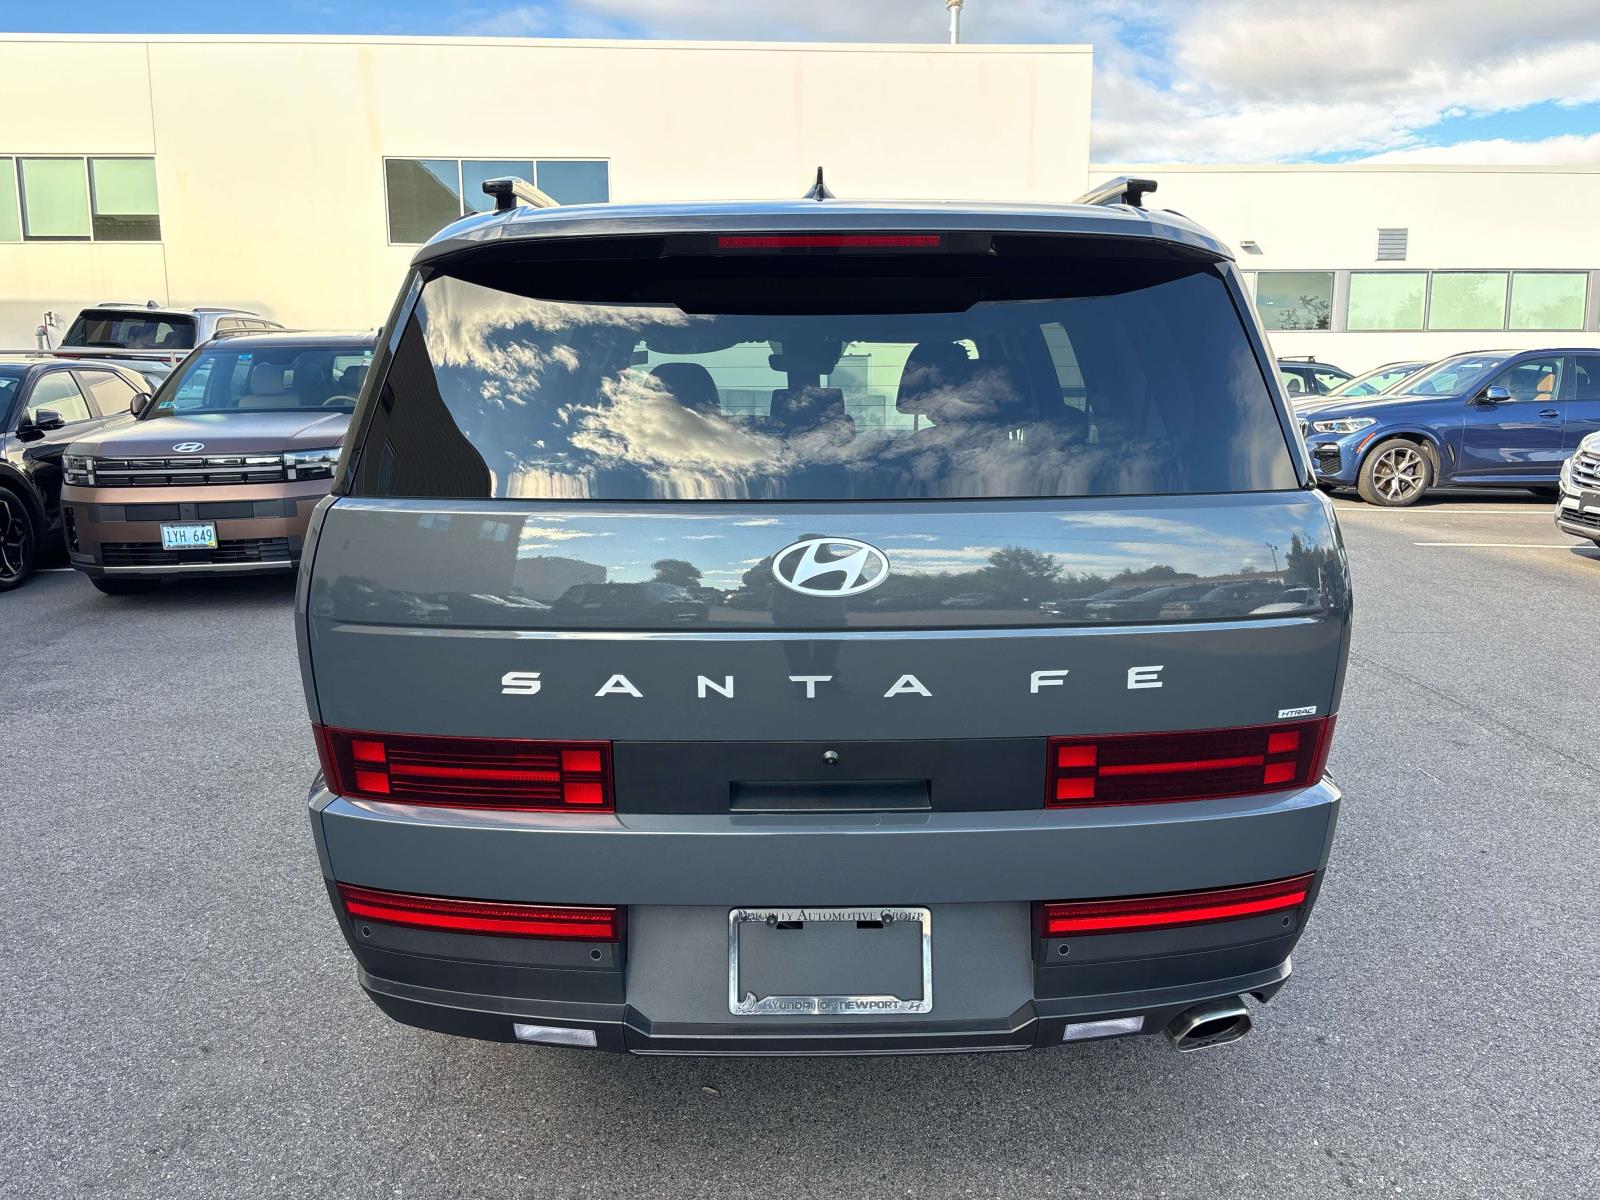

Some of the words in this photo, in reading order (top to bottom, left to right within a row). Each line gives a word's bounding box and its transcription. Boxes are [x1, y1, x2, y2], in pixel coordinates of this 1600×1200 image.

[166, 530, 187, 543] 1YH
[193, 529, 213, 542] 649
[500, 671, 932, 698] SANTA
[1030, 664, 1164, 694] FE
[1280, 707, 1315, 717] HTRAC
[798, 909, 877, 921] AUTOMOTIVE
[763, 1001, 814, 1010] HYUNDAI
[820, 1001, 833, 1010] OF
[839, 1001, 900, 1010] NEWPORT
